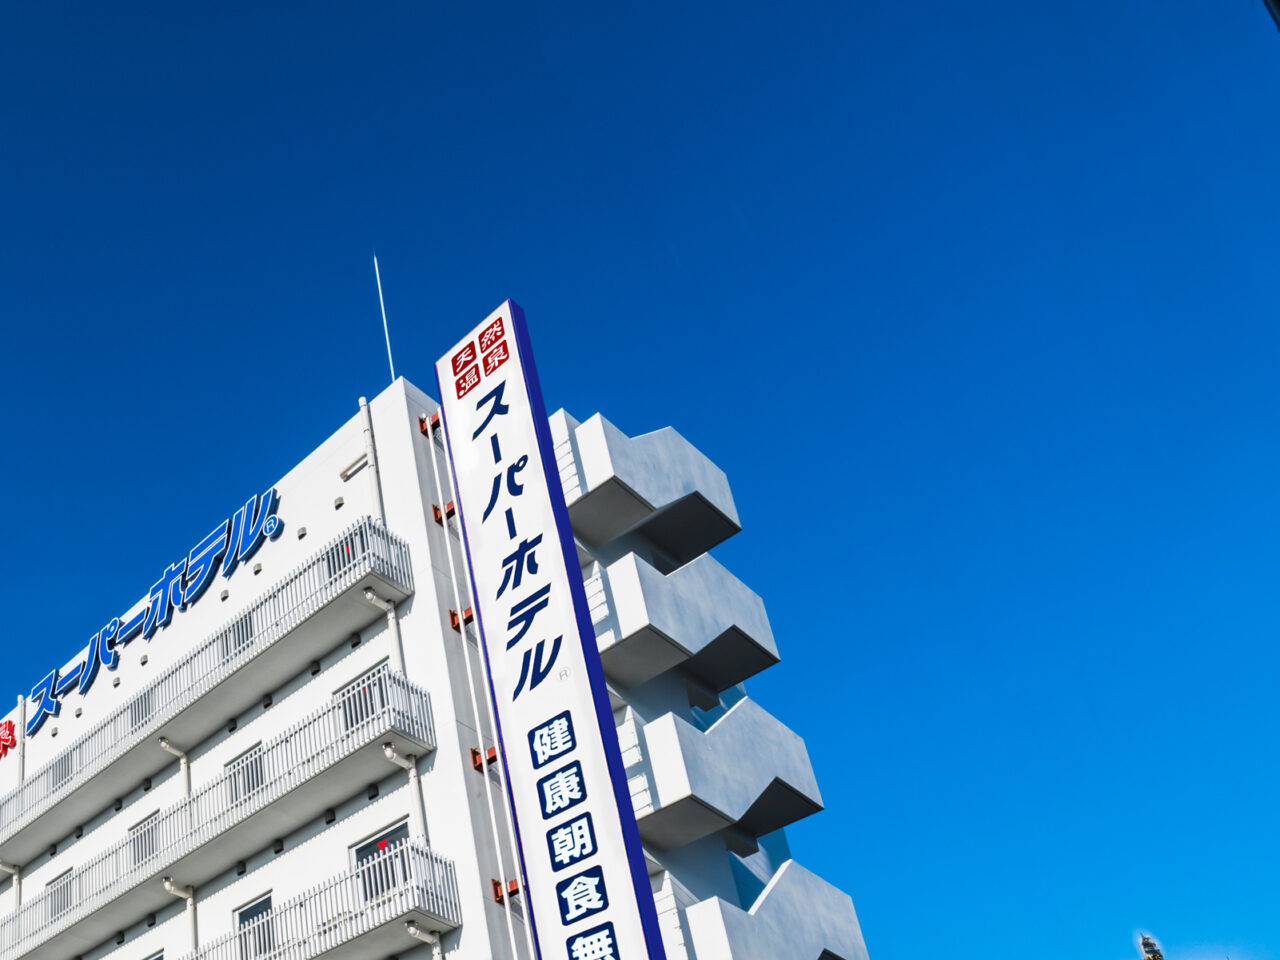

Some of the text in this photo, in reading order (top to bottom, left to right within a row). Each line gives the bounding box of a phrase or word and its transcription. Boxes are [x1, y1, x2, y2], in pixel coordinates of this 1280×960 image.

[455, 319, 503, 374] 天然
[457, 344, 509, 398] 温泉
[25, 488, 280, 738] スーパーホテル
[471, 379, 564, 703] スーパーホテル
